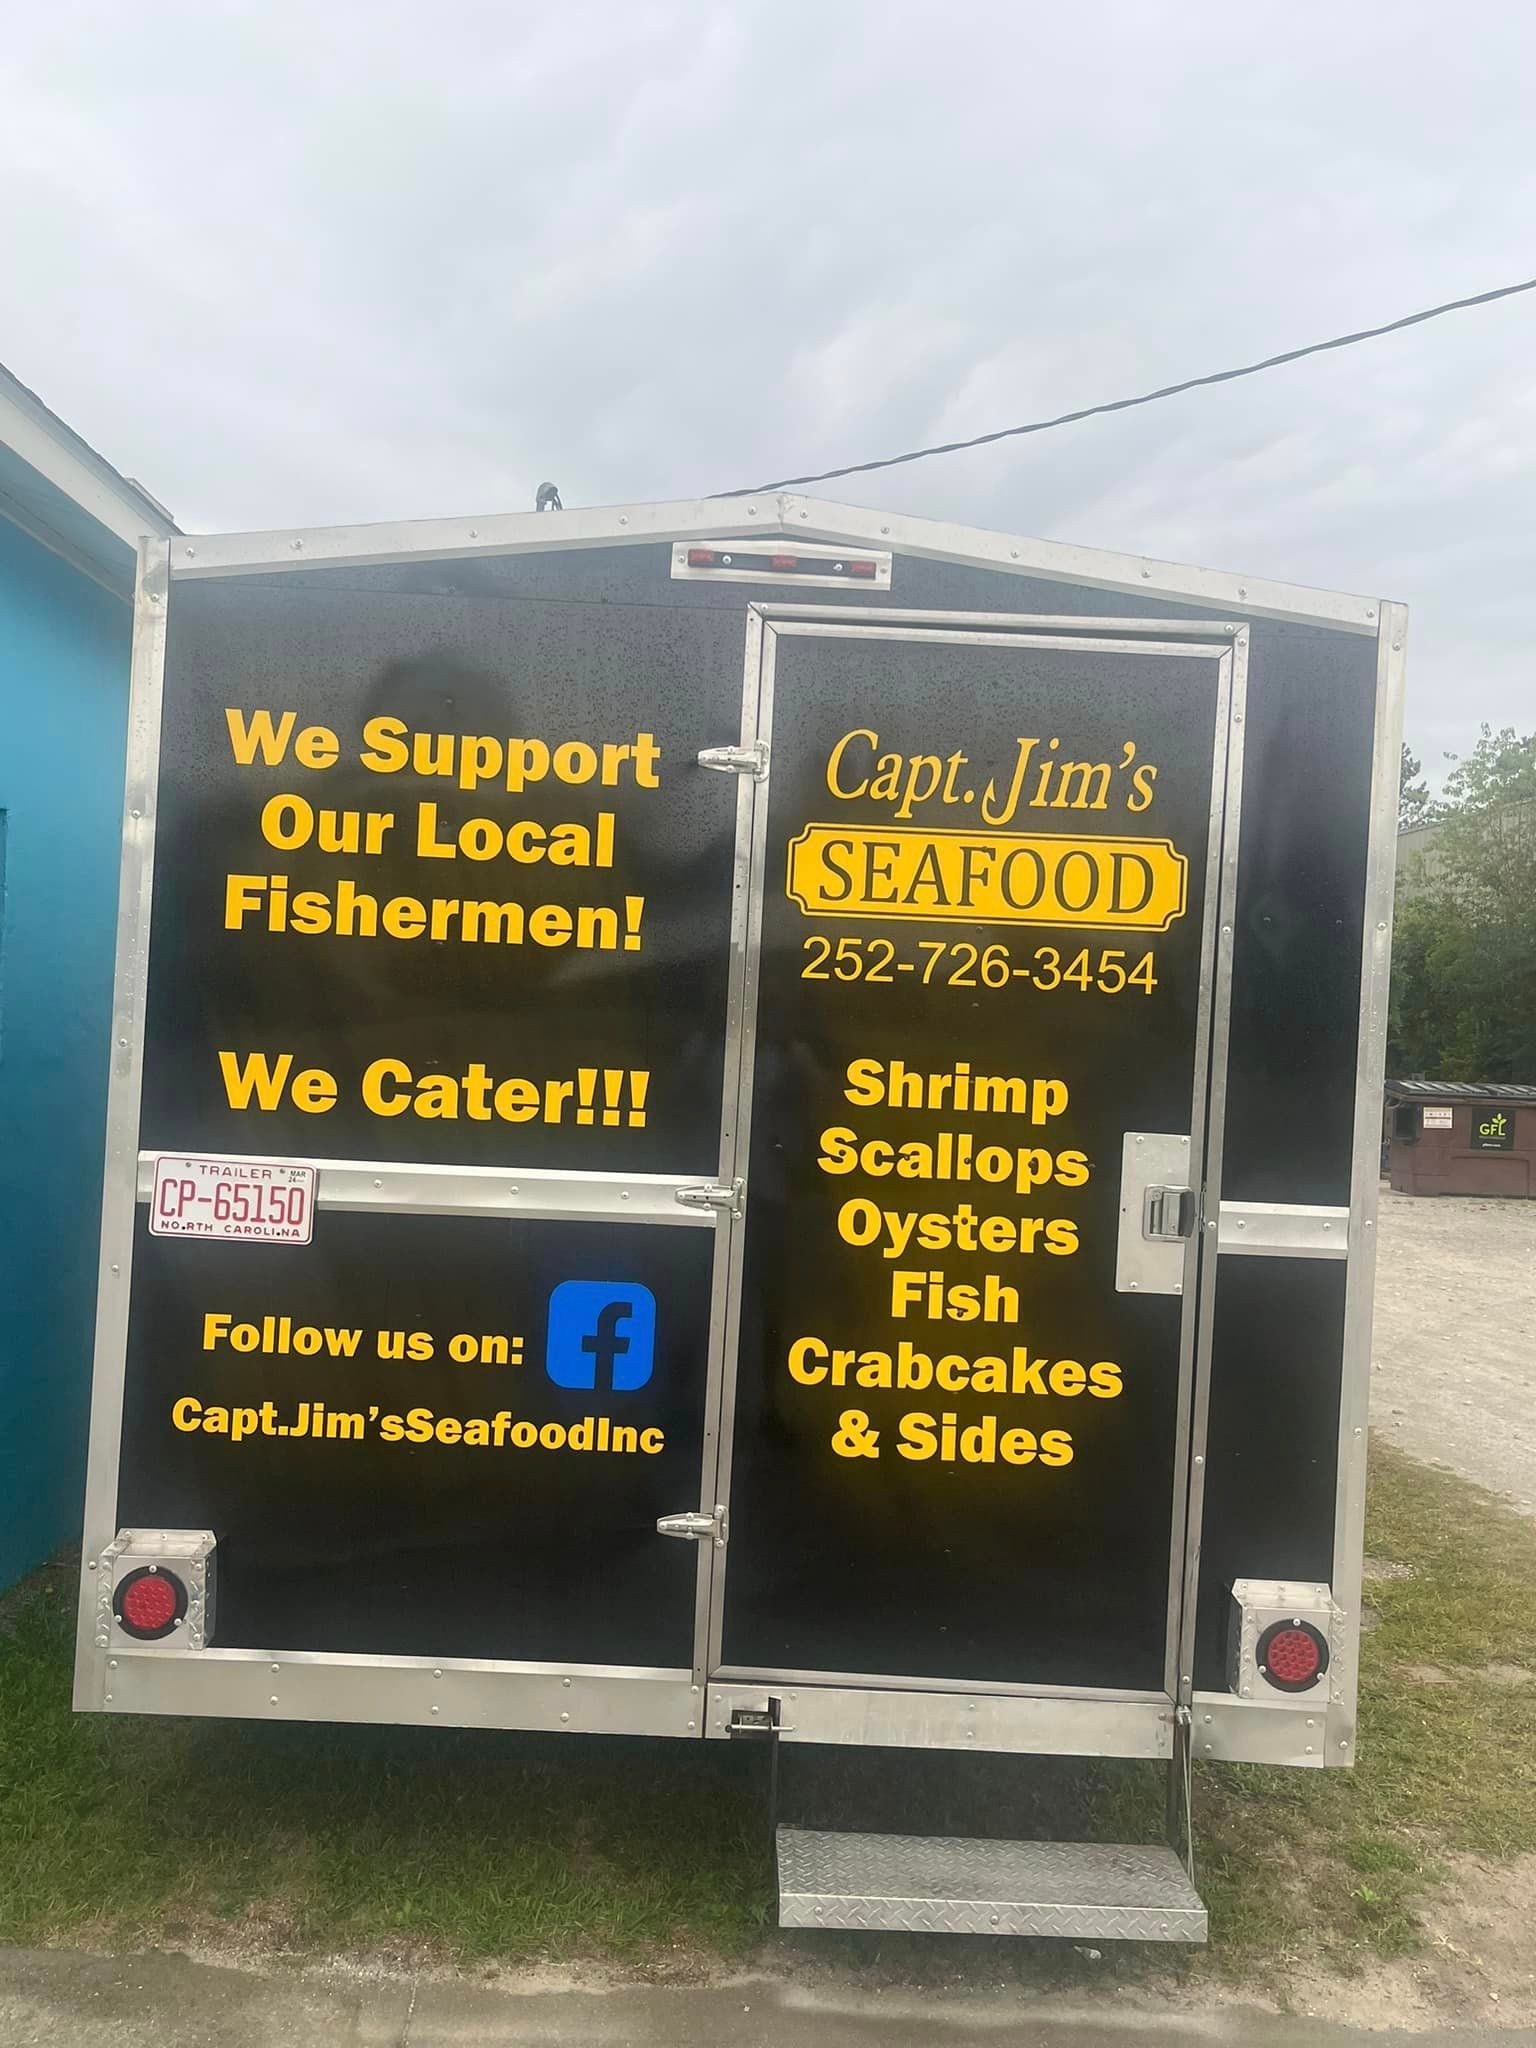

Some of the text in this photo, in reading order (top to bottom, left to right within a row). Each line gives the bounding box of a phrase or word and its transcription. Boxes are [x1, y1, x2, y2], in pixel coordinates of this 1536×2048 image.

[225, 709, 661, 794] We Support
[826, 728, 1159, 827] Capt. Jim's
[260, 793, 616, 869] Our Local
[818, 839, 1155, 914] SEAFOOD
[223, 873, 646, 952] Fishermen!
[800, 935, 1158, 996] 252-726-3454
[218, 1051, 651, 1129] We Cater!!!
[843, 1058, 1070, 1126] Shrimp
[1479, 1117, 1507, 1136] GFL
[200, 1164, 272, 1180] TRAILER
[816, 1126, 1091, 1196] Scallops
[159, 1178, 305, 1226] CP-65150
[161, 1220, 301, 1238] NORTH CAROLINA
[836, 1198, 1081, 1260] Oysters
[890, 1269, 1021, 1324] Fish
[202, 1312, 525, 1366] Follow us on:
[787, 1336, 1125, 1400] Crabcakes
[830, 1408, 1076, 1468] & Sides
